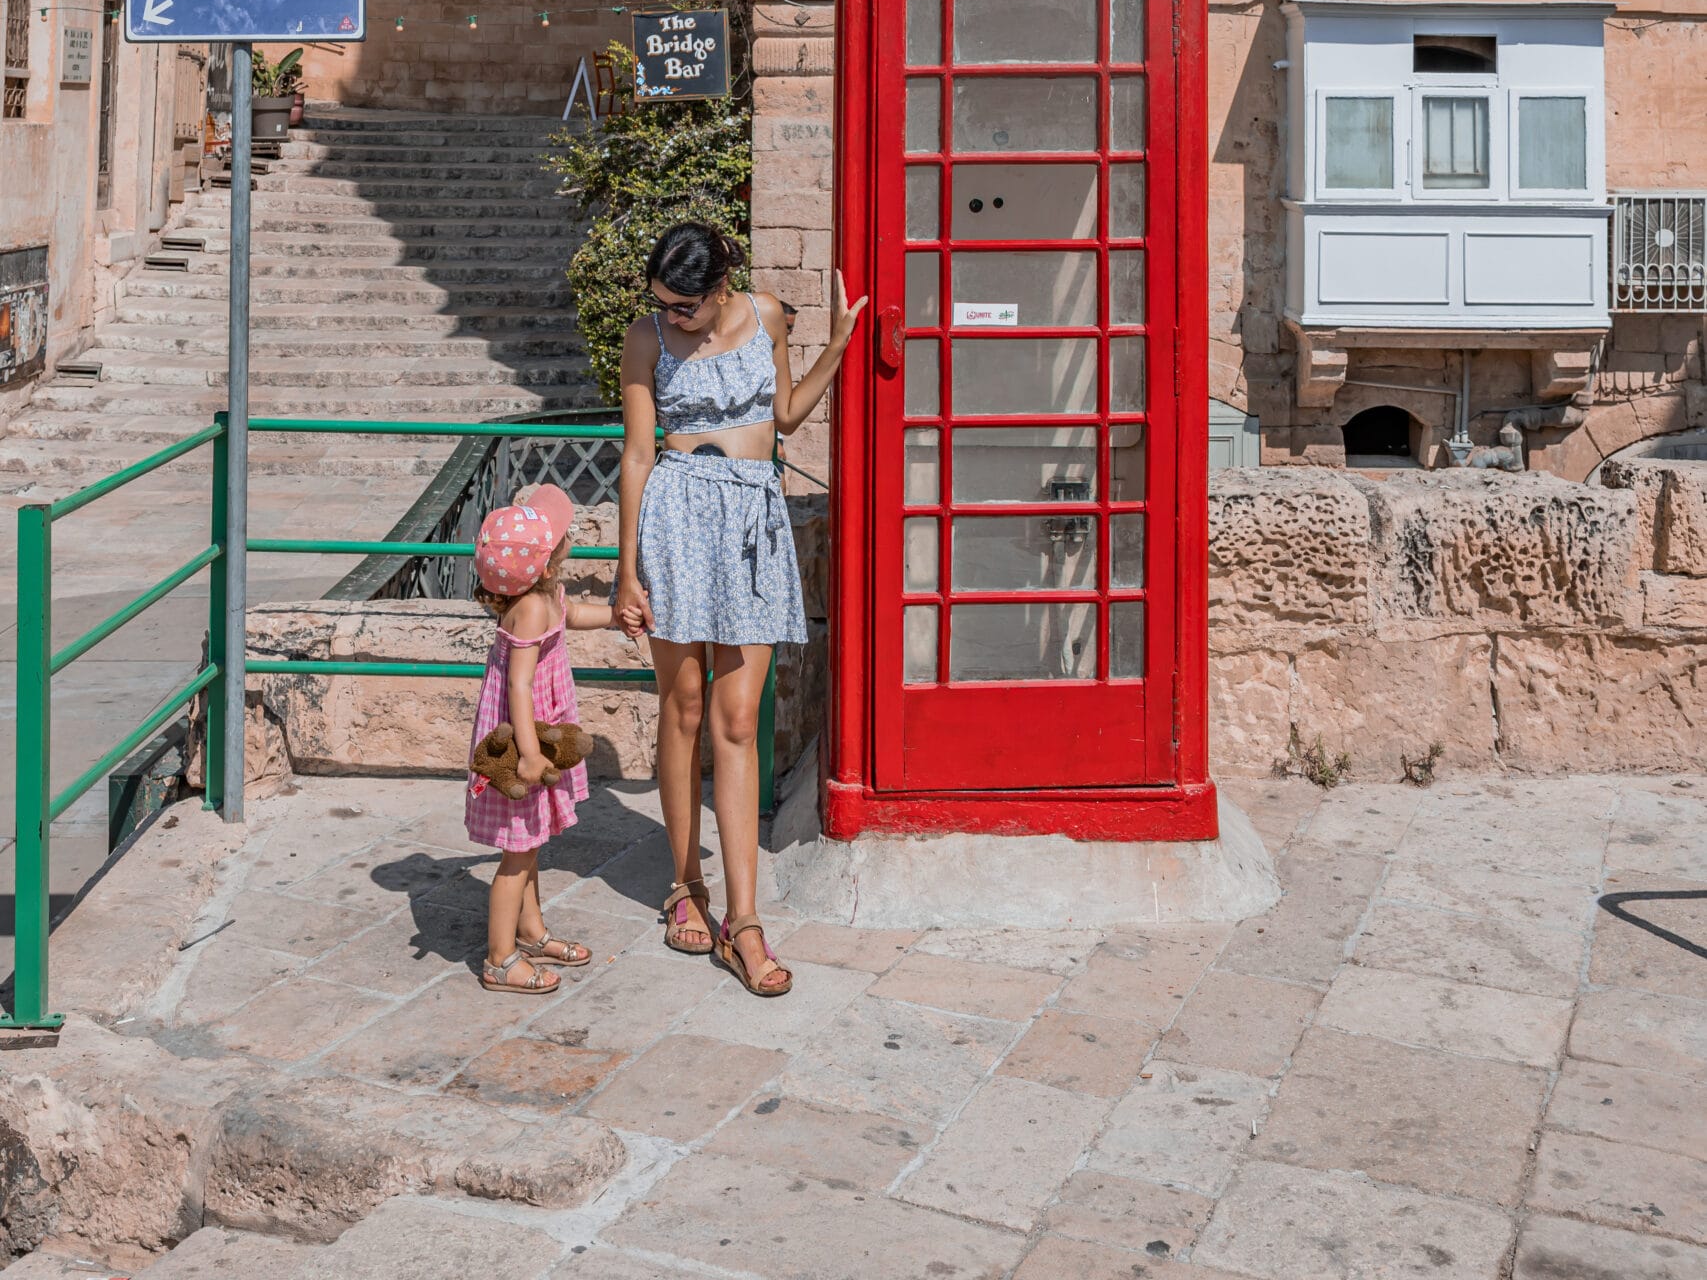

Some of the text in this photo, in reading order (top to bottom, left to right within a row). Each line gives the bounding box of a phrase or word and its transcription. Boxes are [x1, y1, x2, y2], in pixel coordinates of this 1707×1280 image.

[659, 15, 697, 32] The
[646, 34, 716, 60] Bridge
[664, 57, 705, 79] Bar
